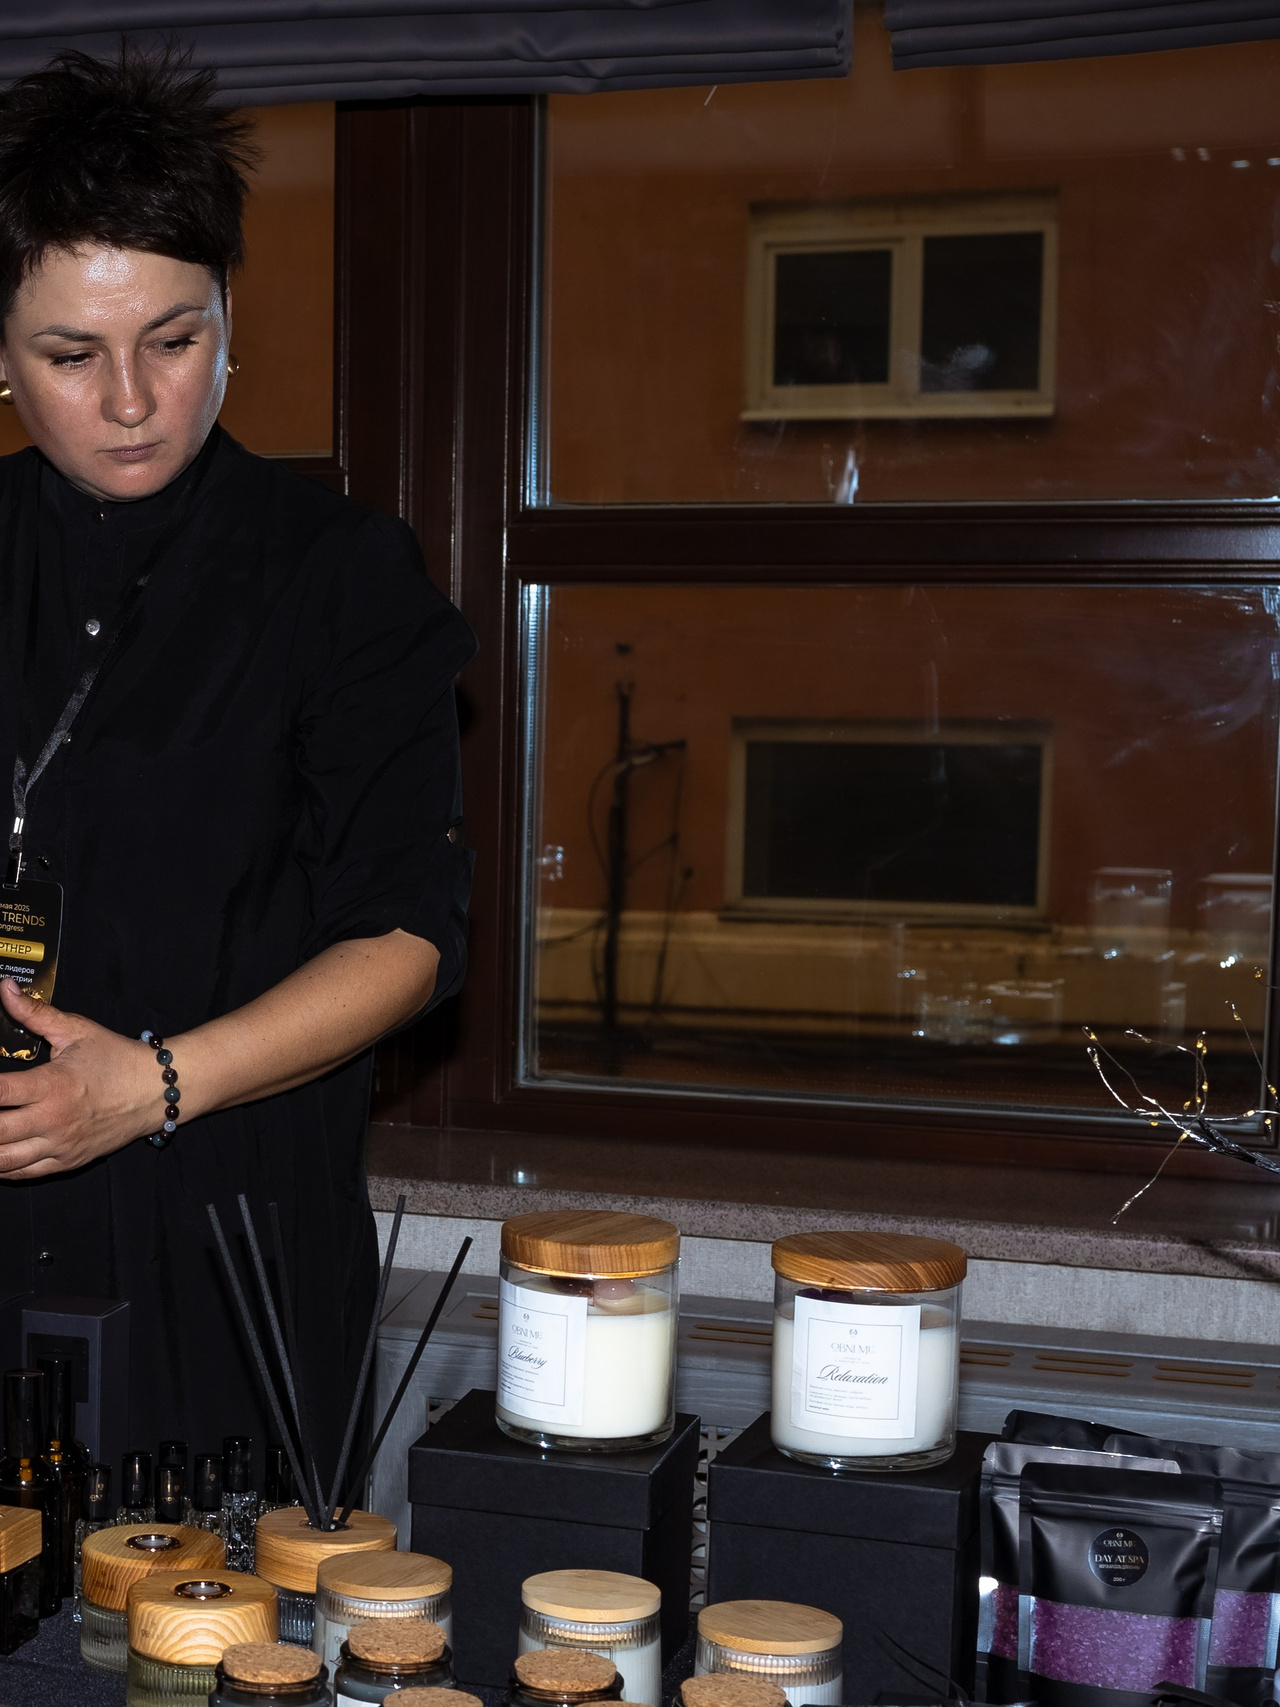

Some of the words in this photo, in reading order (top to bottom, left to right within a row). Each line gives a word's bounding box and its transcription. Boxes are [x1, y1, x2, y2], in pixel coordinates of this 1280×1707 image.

[0, 902, 13, 910] мая
[14, 904, 30, 912] 2025
[2, 911, 46, 927] TRENDS
[4, 964, 35, 975] лидеров
[512, 1324, 528, 1338] OBNI
[830, 1342, 855, 1354] OBNI
[508, 1345, 548, 1369] Blueberry
[816, 1364, 888, 1384] Relaxation
[1095, 1554, 1113, 1562] DAY
[1115, 1555, 1127, 1563] AT
[1128, 1555, 1145, 1564] SPA
